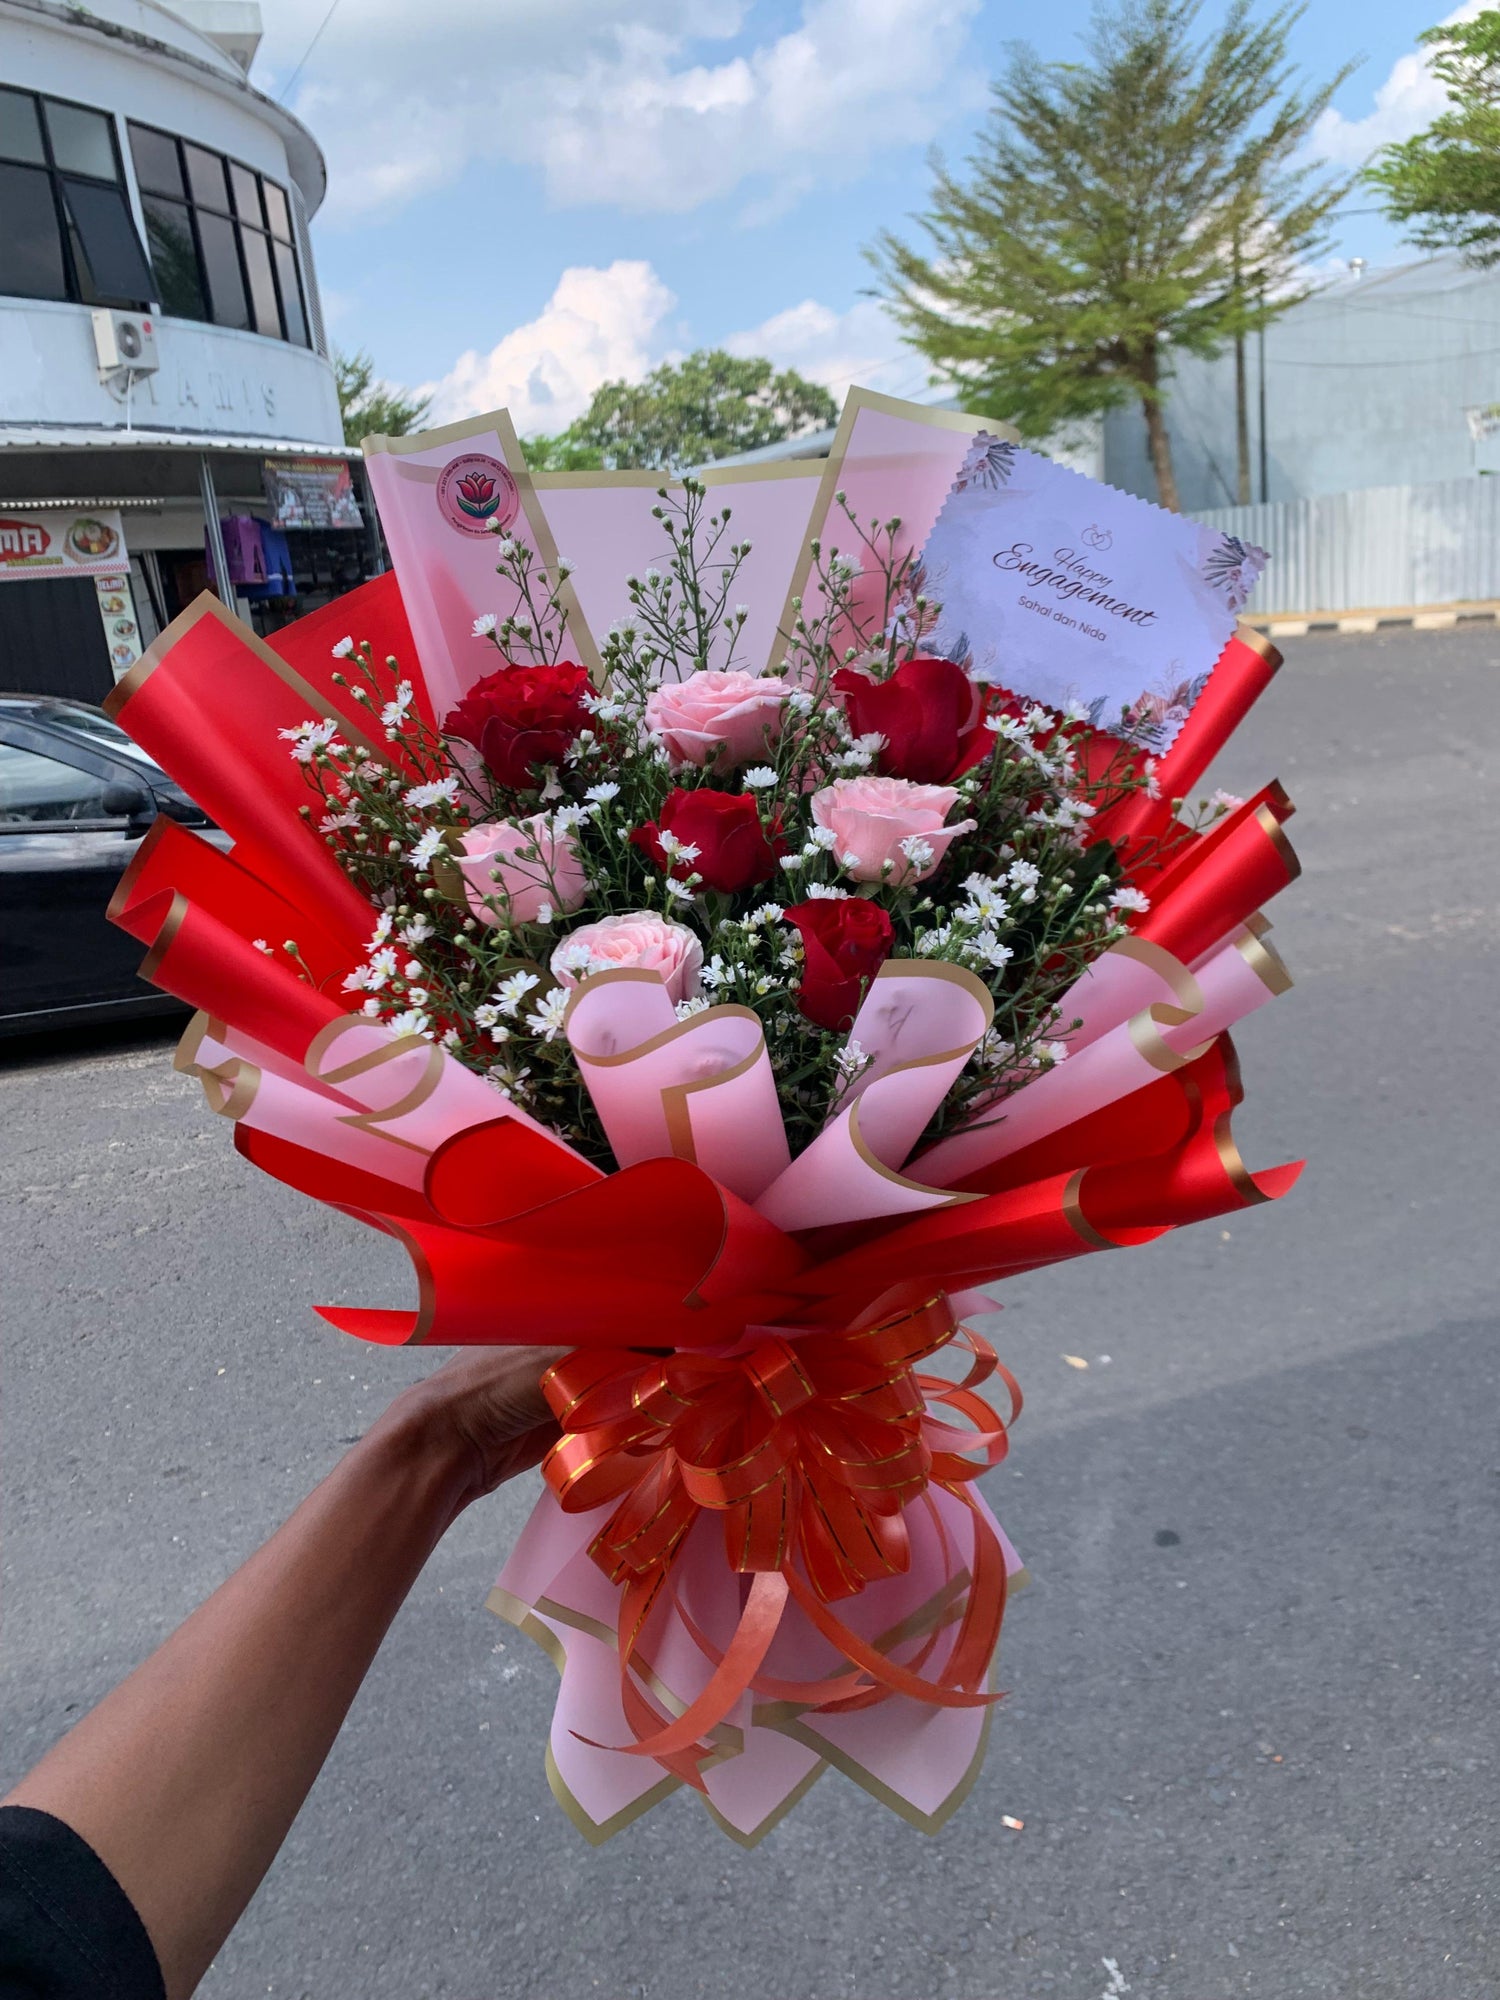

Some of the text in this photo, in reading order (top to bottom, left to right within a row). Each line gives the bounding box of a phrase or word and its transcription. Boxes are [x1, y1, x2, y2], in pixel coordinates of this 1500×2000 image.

[992, 543, 1160, 627] Engagement
[1053, 547, 1114, 588] Happy
[1018, 595, 1107, 641] Sahal dan Nida
